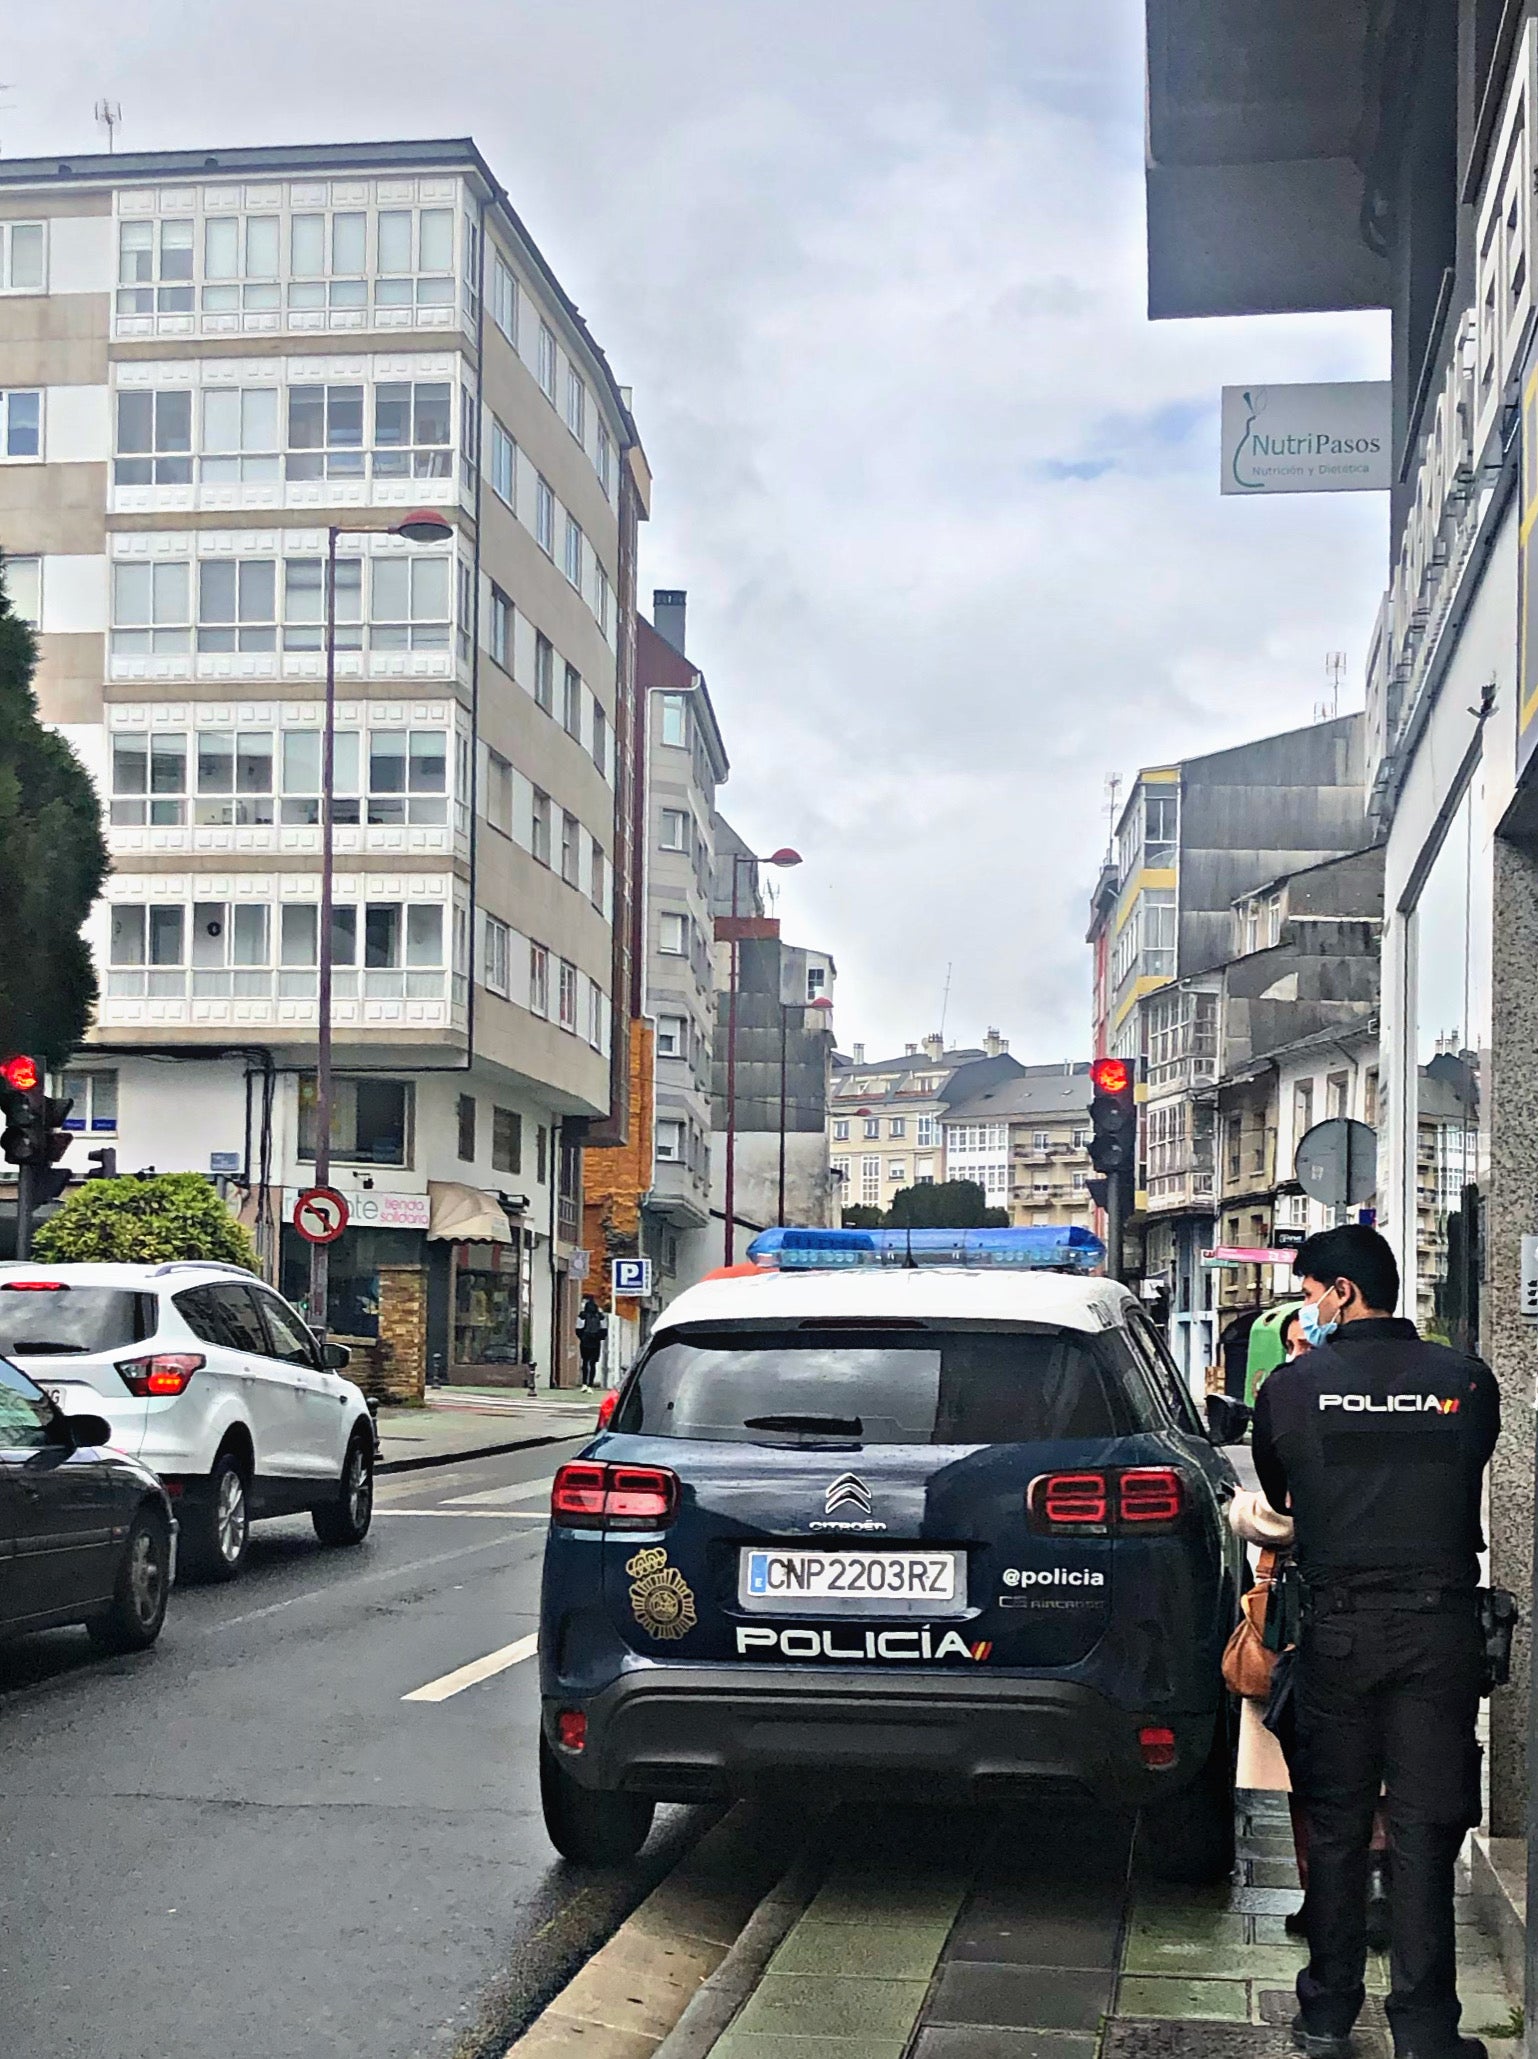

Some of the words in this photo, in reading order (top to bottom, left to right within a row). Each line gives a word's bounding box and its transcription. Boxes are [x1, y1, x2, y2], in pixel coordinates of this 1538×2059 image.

[1252, 433, 1381, 457] NutriPasos
[1308, 467, 1315, 477] y
[620, 1263, 640, 1286] P
[1319, 1394, 1443, 1412] POLICIA
[1002, 1567, 1105, 1589] @policia
[735, 1623, 973, 1659] POLICÍA
